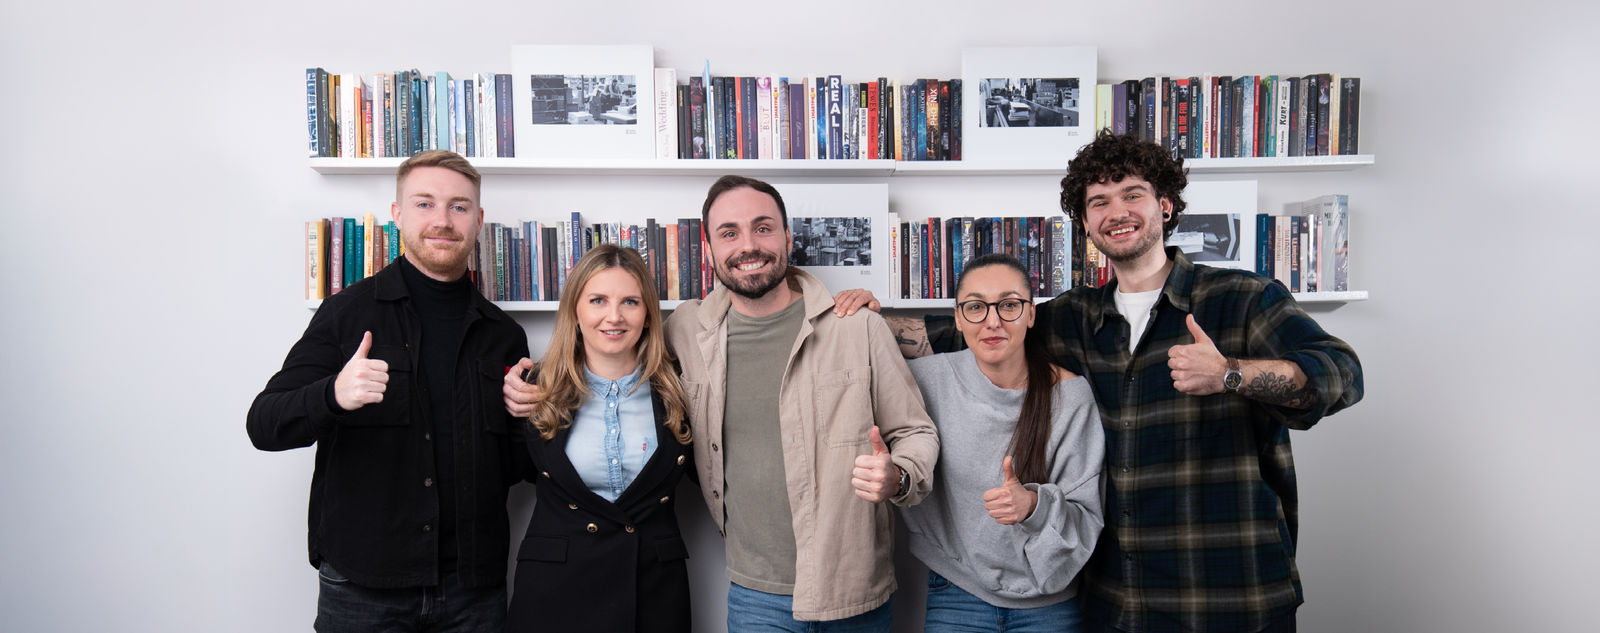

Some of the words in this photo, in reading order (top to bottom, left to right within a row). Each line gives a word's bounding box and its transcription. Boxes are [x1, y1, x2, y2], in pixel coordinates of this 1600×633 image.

[658, 90, 668, 132] Wedding
[830, 77, 841, 127] REAL
[1179, 102, 1187, 114] FOR
[1279, 106, 1287, 125] KURT
[1179, 126, 1185, 134] TO
